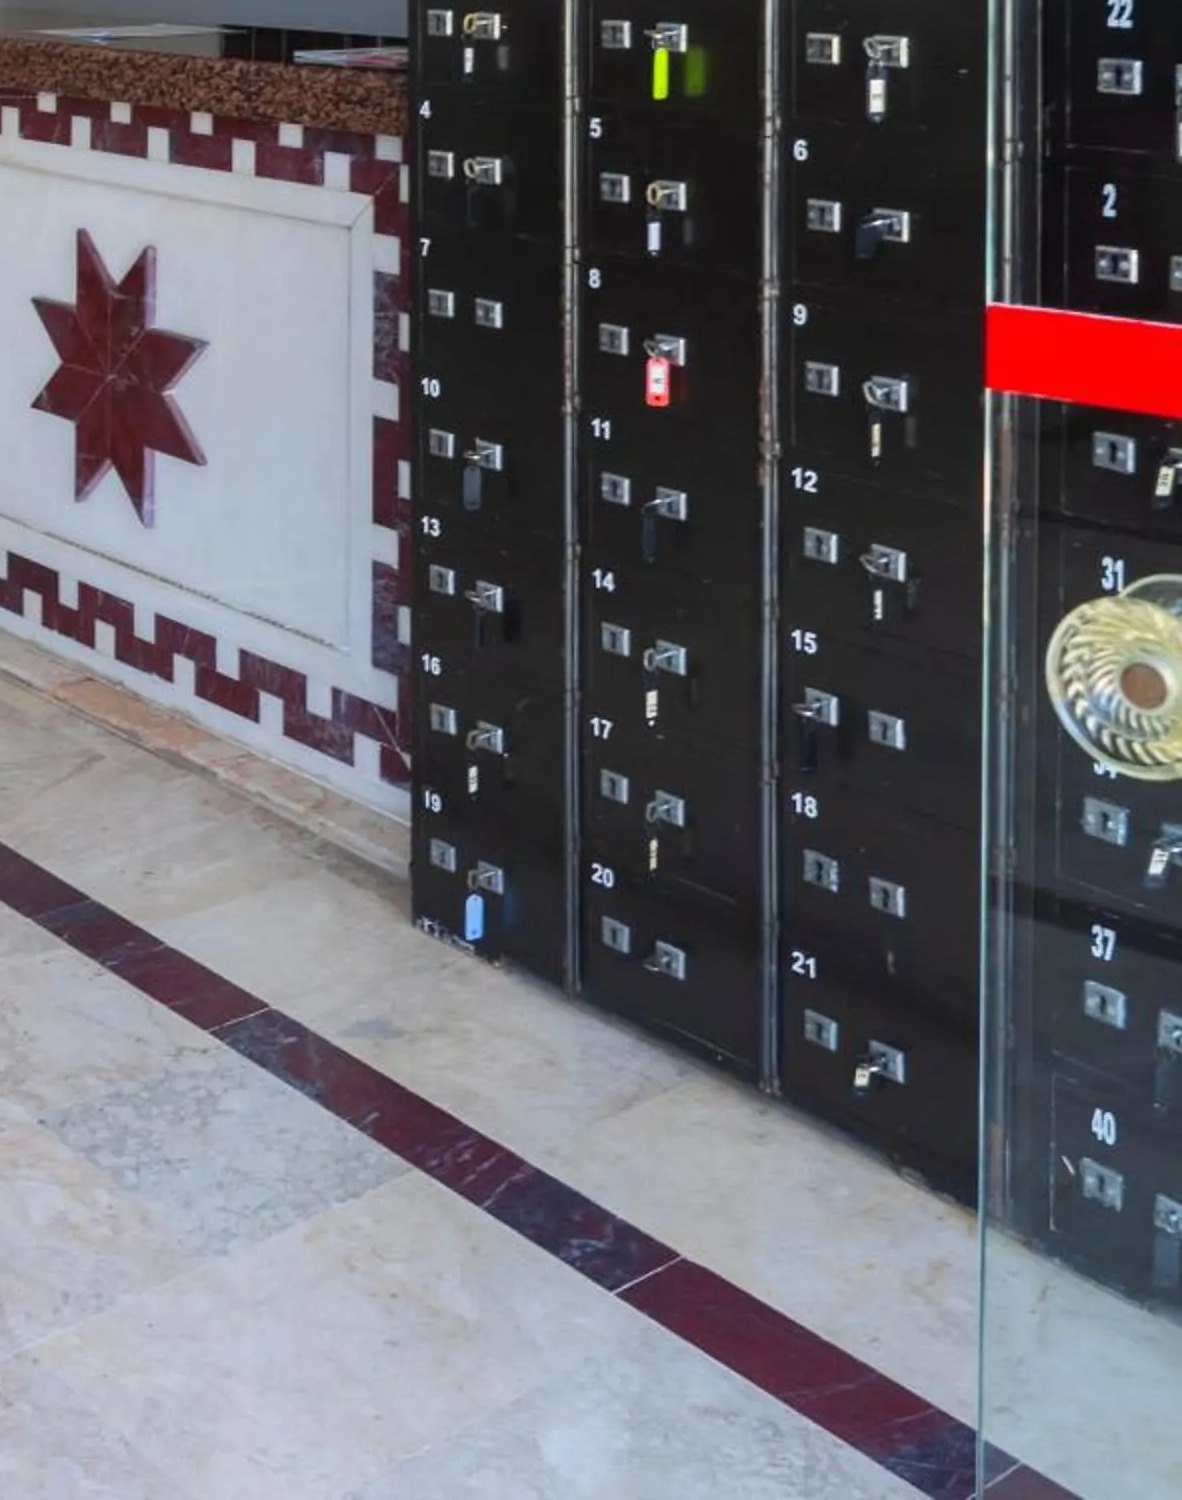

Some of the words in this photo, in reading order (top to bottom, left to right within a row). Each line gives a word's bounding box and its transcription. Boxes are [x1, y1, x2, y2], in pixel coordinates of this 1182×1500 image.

[419, 99, 432, 119] 4
[589, 117, 602, 139] 5
[793, 139, 809, 161] 6
[419, 237, 431, 256] 7
[588, 268, 601, 289] 8
[793, 303, 807, 326] 9
[421, 377, 441, 398] 10
[591, 417, 611, 439] 11
[791, 467, 818, 493] 12
[421, 515, 441, 537] 13
[592, 568, 616, 592] 14
[1101, 556, 1125, 594] 31
[790, 629, 818, 655] 15
[421, 653, 442, 676] 16
[589, 716, 613, 740] 17
[424, 789, 442, 813] 19
[791, 792, 819, 819] 18
[591, 862, 615, 888] 20
[1090, 924, 1116, 962] 37
[791, 950, 816, 979] 21
[1091, 1107, 1117, 1146] 40
